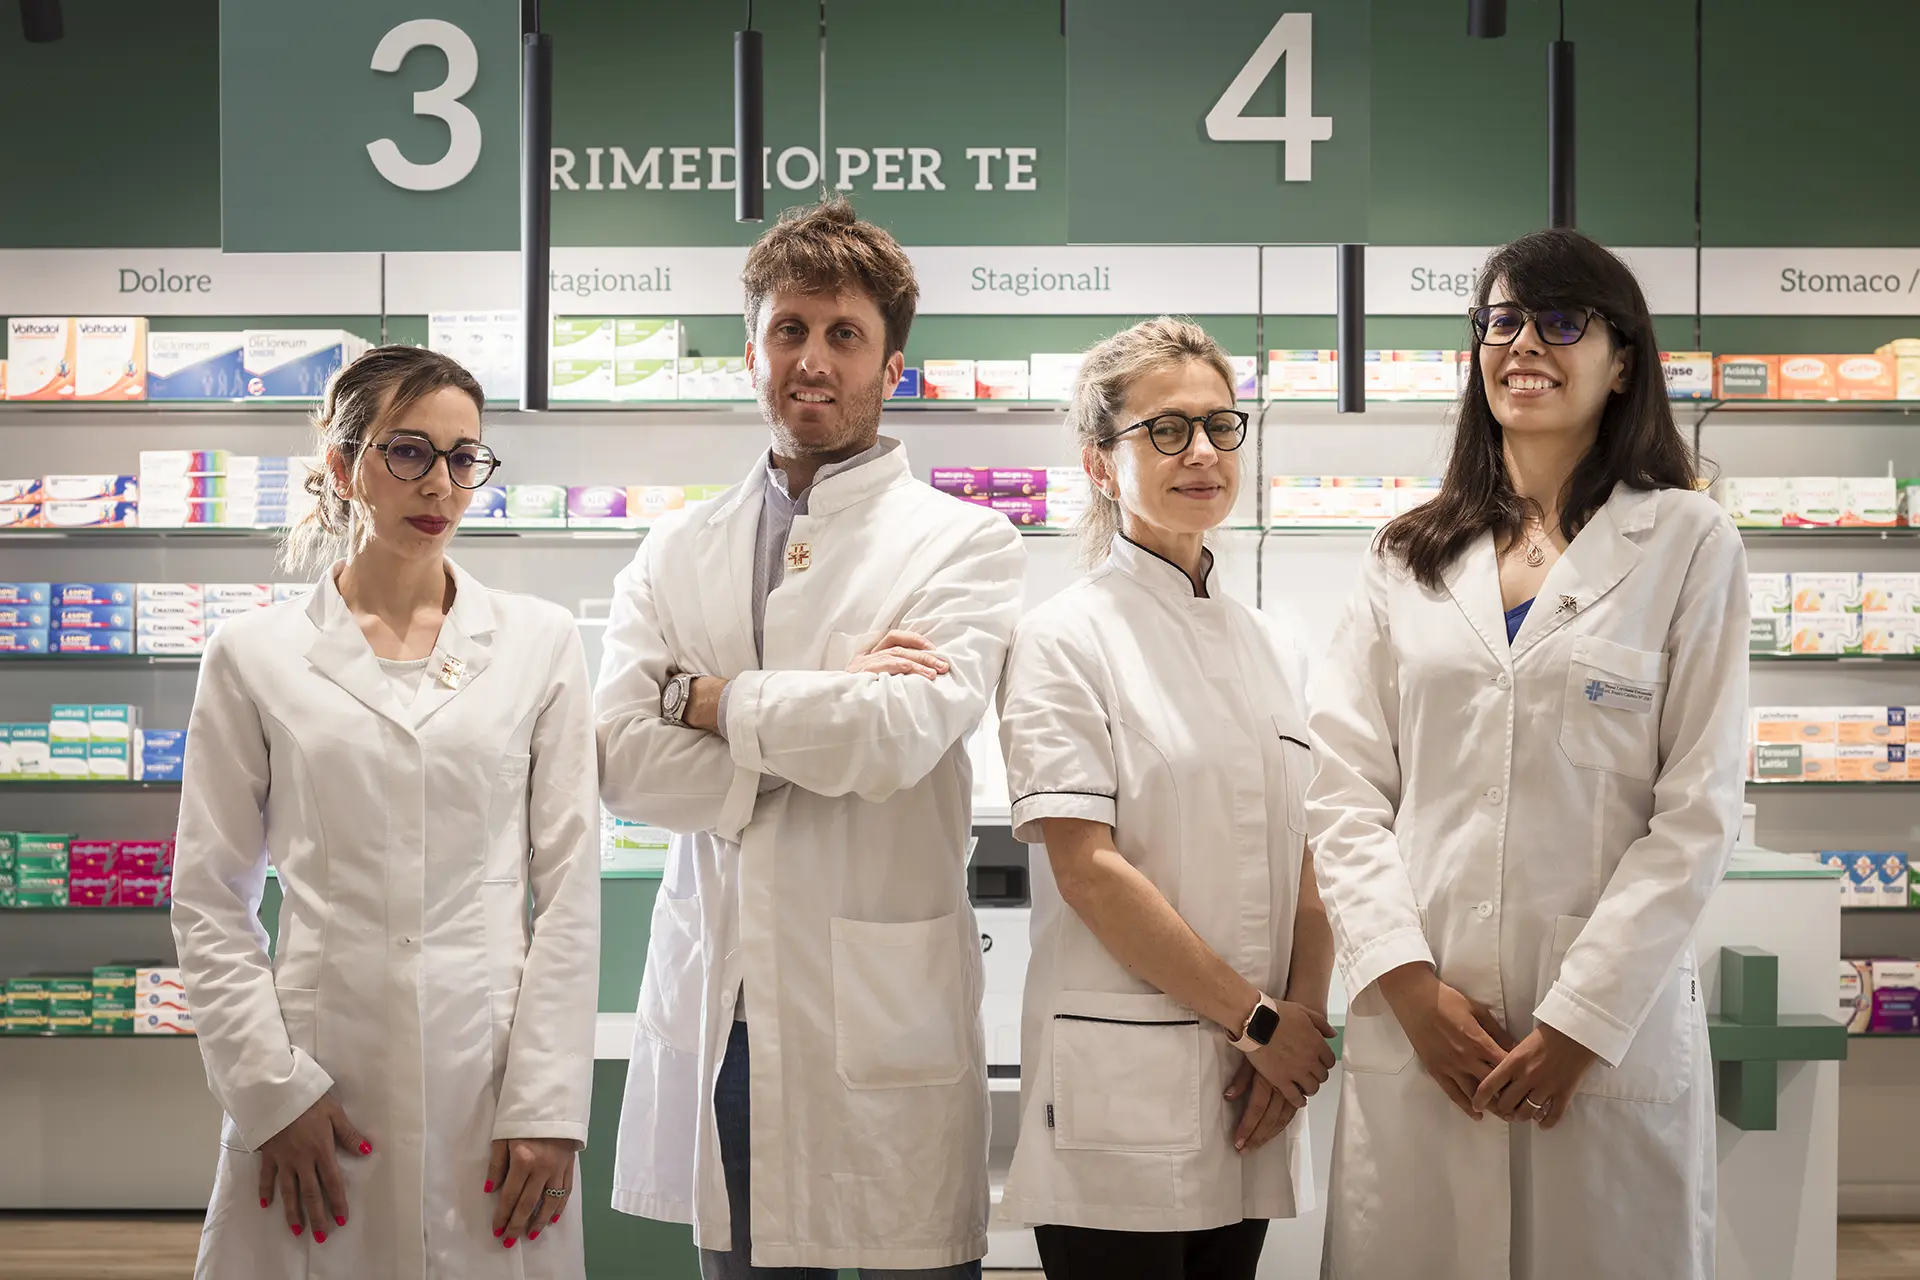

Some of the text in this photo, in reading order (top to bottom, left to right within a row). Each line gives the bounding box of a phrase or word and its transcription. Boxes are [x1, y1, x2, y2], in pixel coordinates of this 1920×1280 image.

[366, 19, 482, 191] 3
[1205, 13, 1332, 181] 4
[836, 147, 946, 191] PER
[966, 147, 1037, 190] TE
[119, 268, 212, 294] Dolore
[550, 267, 671, 297] tagionali
[971, 266, 1111, 296] Stagionali
[1411, 267, 1477, 297] Stagi
[1780, 267, 1901, 293] Stomaco
[12, 323, 60, 334] Voltadol
[79, 323, 127, 334] Voltadol
